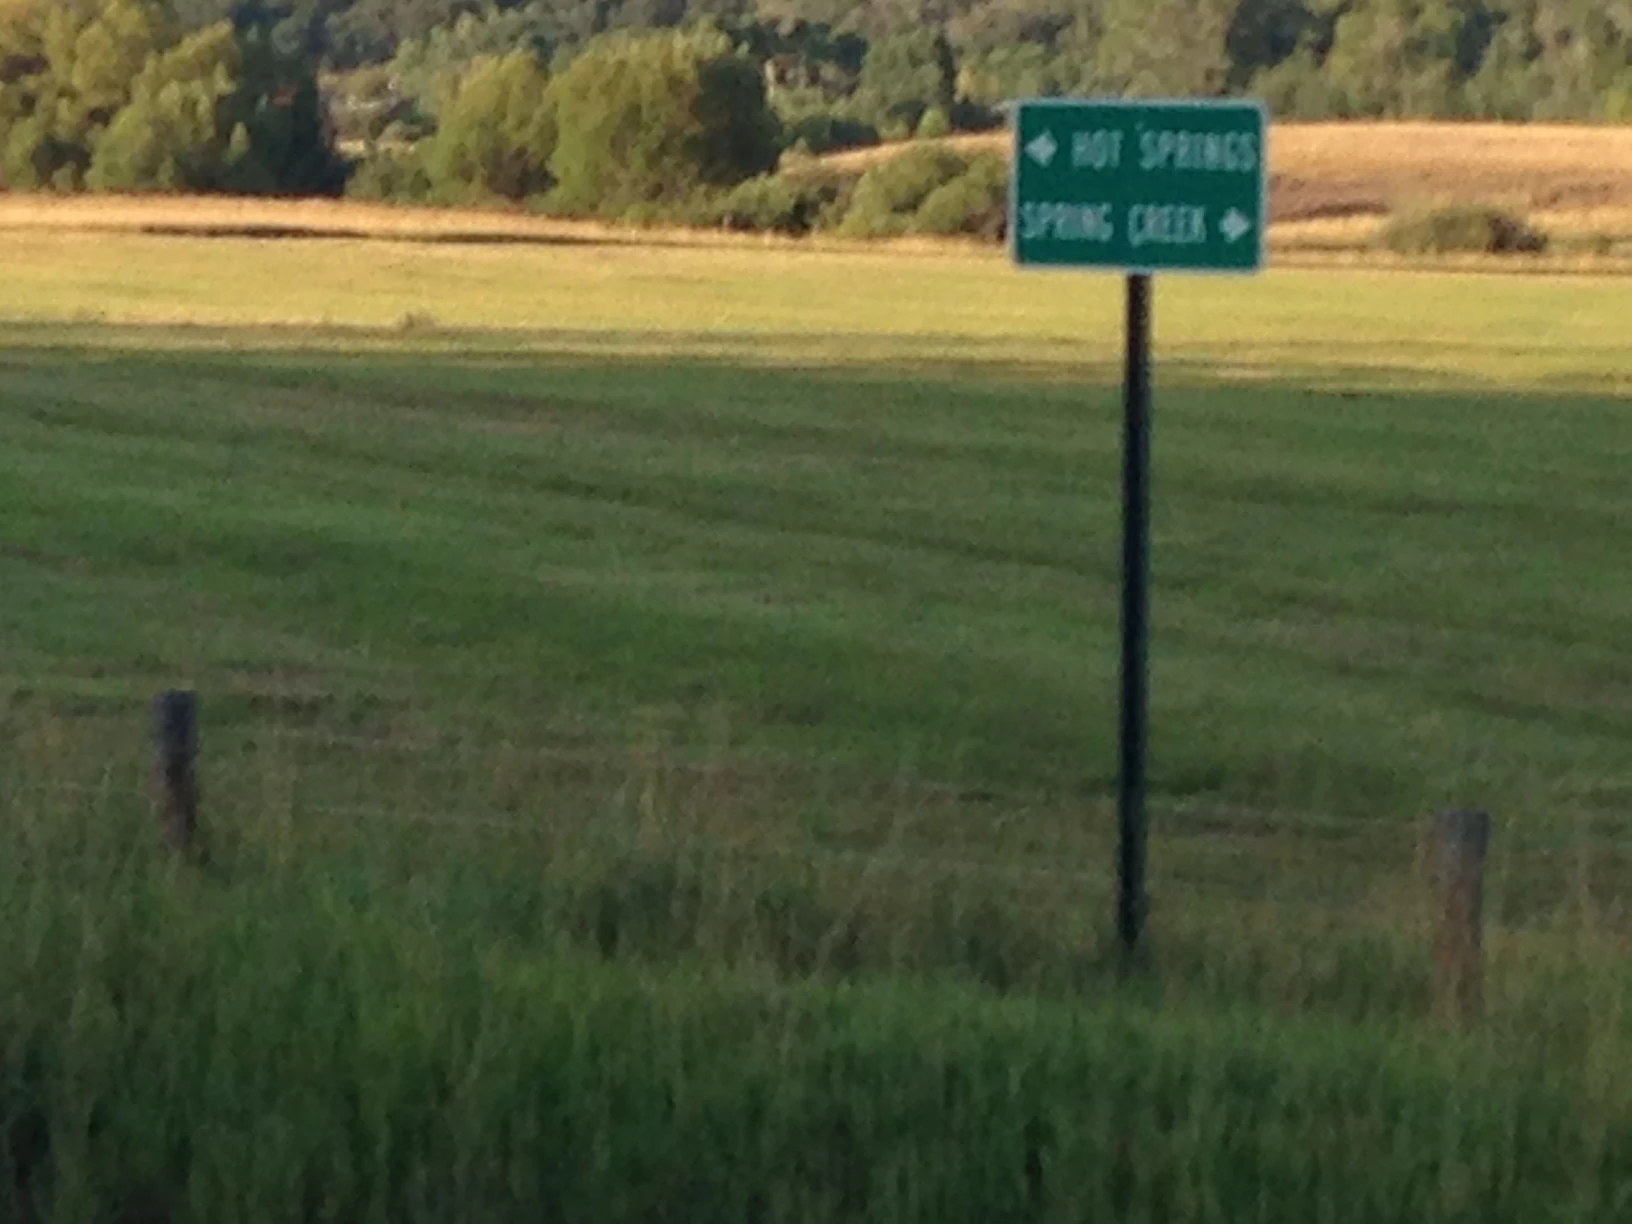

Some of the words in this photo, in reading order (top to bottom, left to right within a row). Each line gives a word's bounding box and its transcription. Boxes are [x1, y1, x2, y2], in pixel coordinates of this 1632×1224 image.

[1072, 130, 1124, 169] HOT
[1139, 130, 1257, 172] SPRINGS
[1020, 202, 1114, 241] SPRING
[1127, 204, 1207, 245] CREEK
